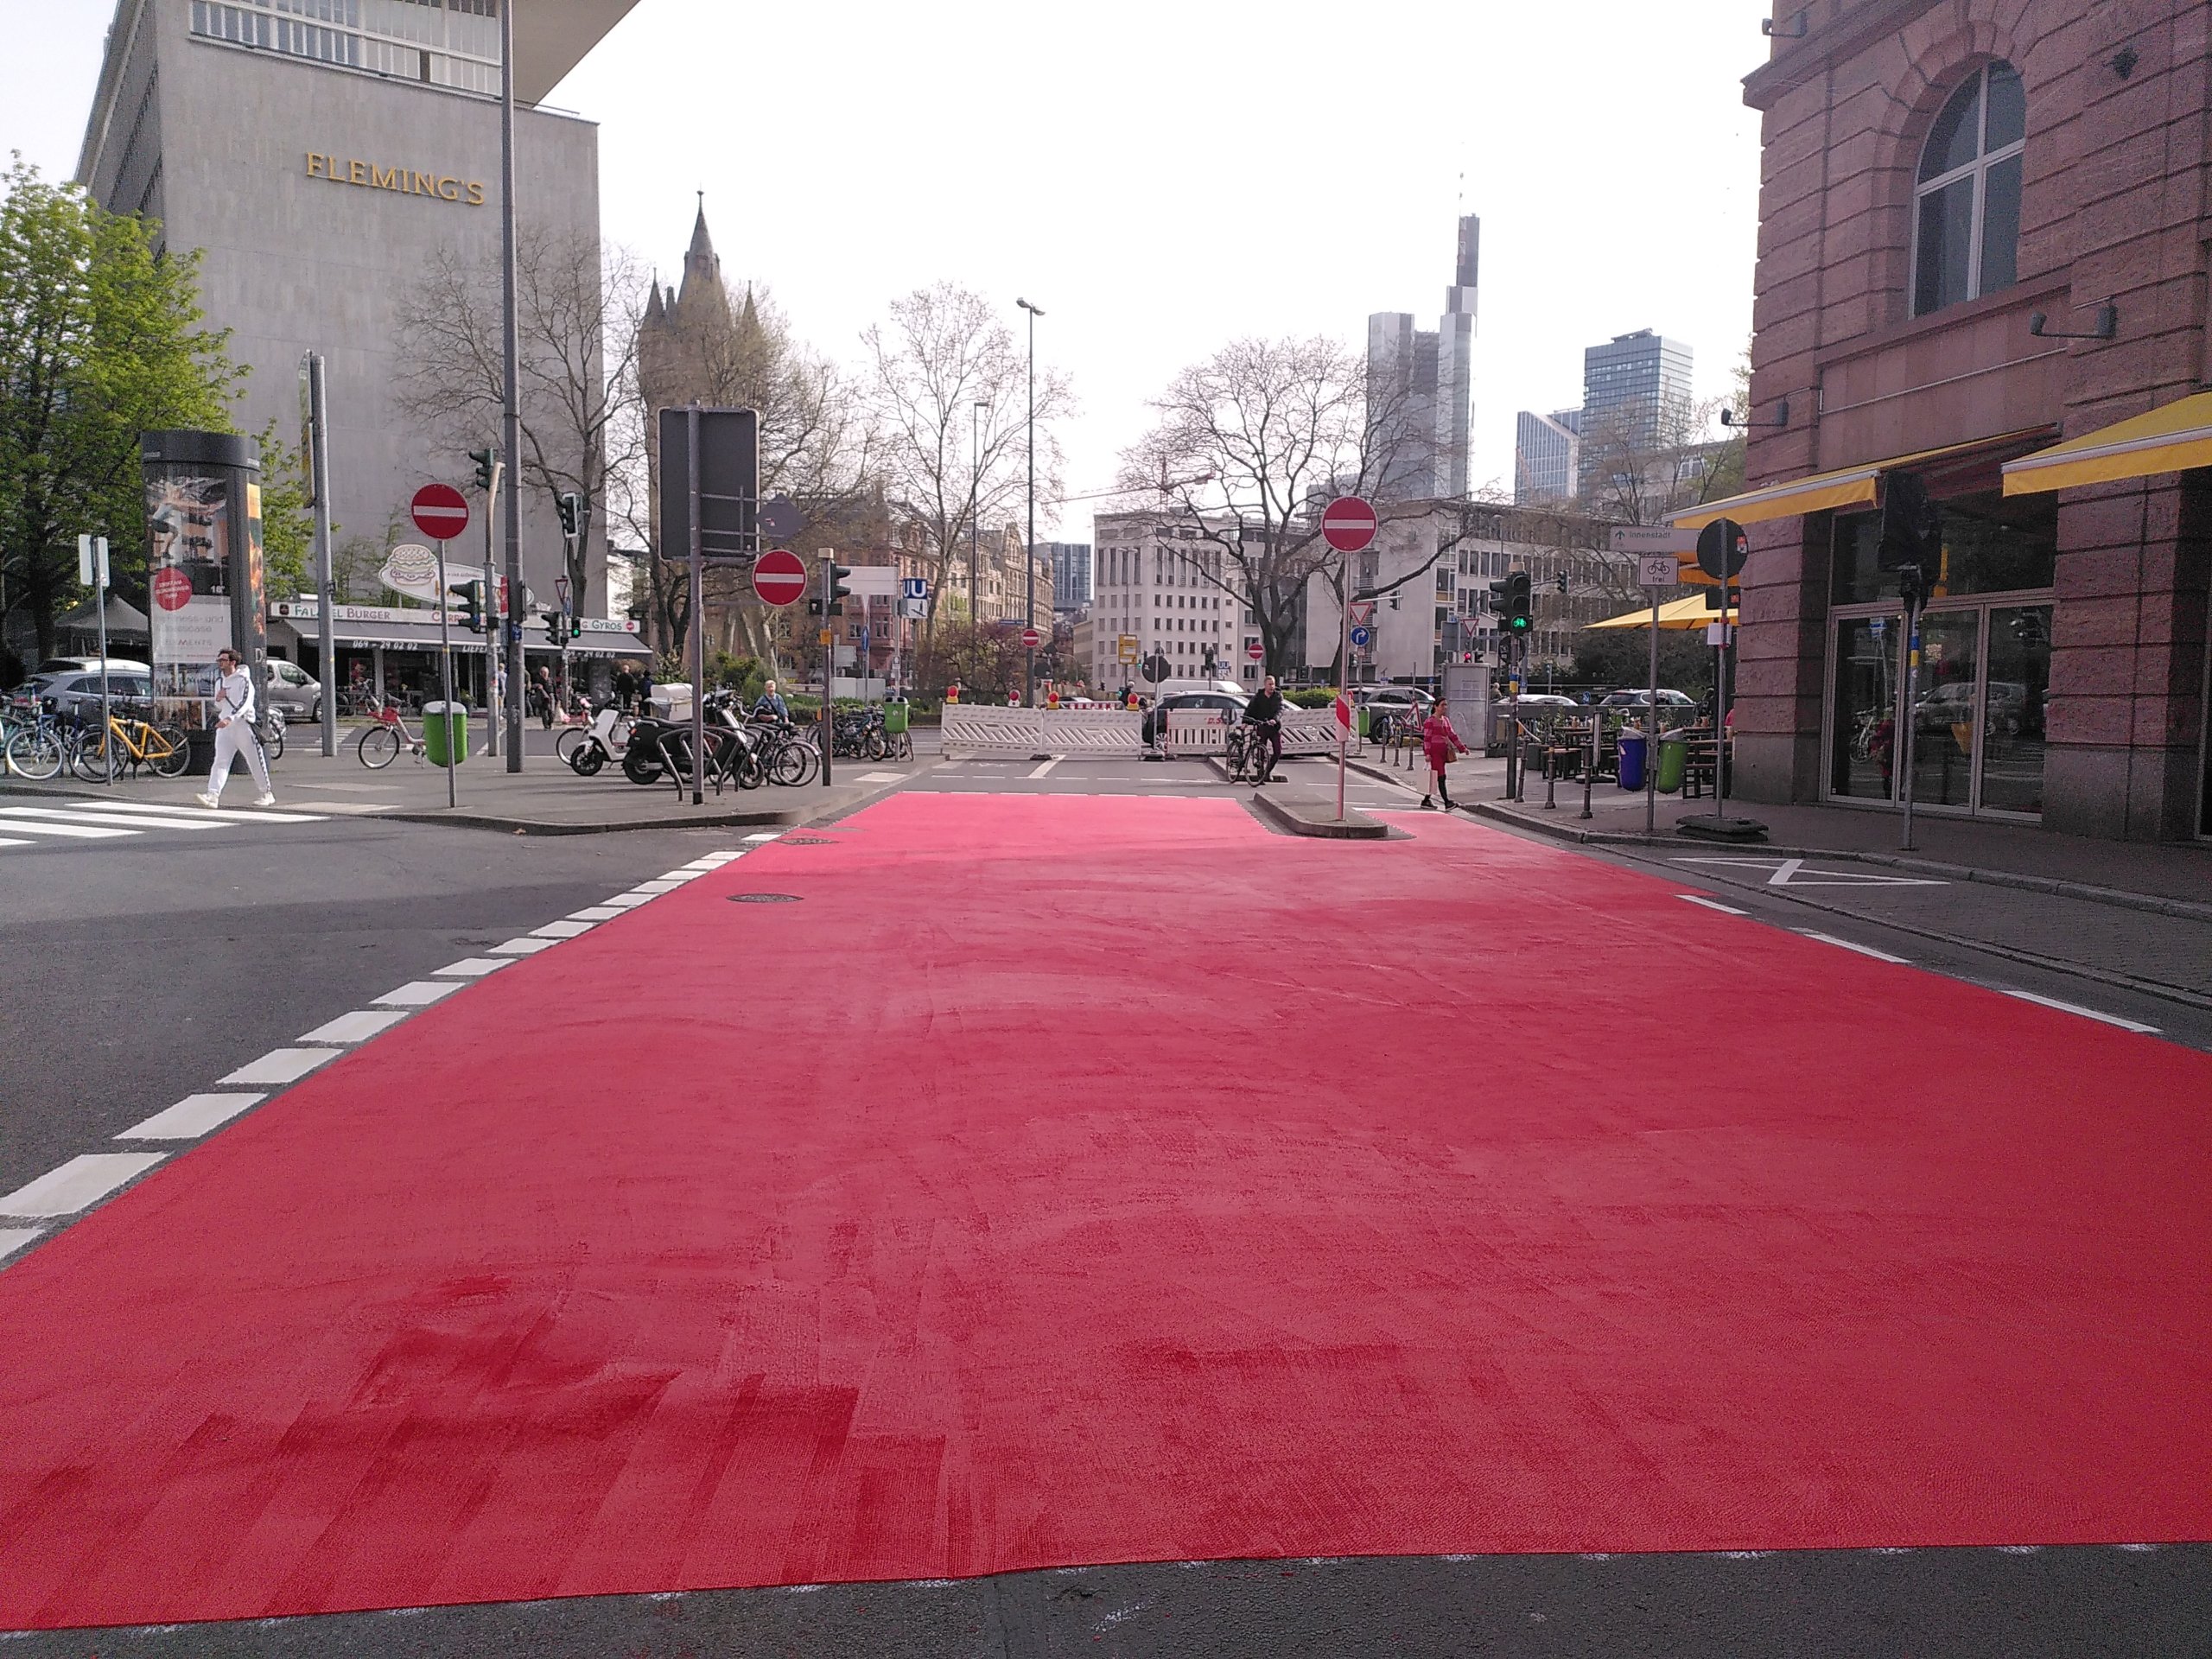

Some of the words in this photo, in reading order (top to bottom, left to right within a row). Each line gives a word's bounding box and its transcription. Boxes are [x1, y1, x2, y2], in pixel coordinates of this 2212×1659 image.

[307, 151, 485, 206] FLEMING'S
[911, 580, 926, 597] U
[346, 608, 391, 620] BURGER
[591, 620, 622, 630] GYROS
